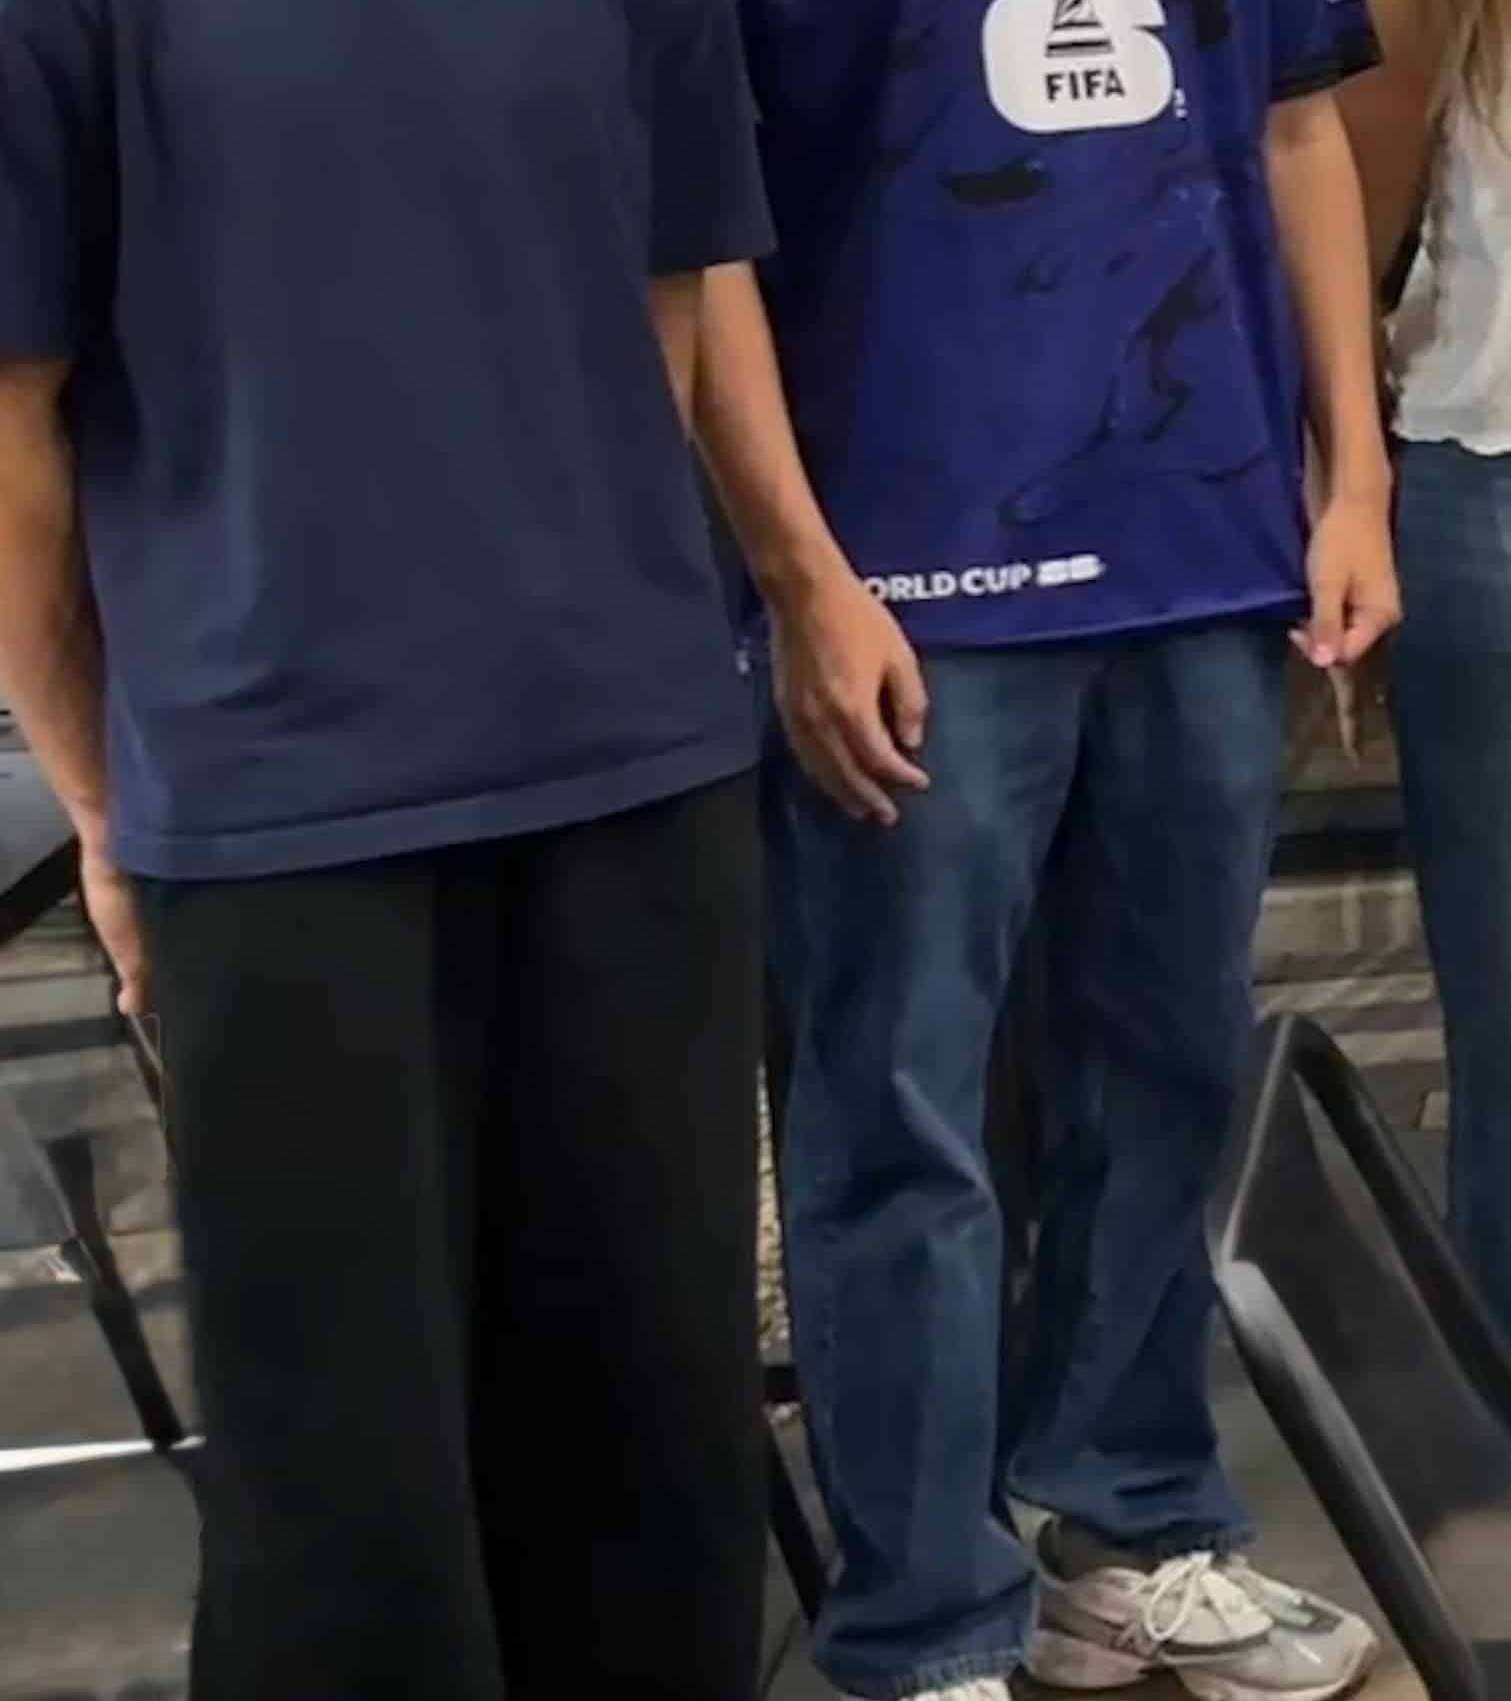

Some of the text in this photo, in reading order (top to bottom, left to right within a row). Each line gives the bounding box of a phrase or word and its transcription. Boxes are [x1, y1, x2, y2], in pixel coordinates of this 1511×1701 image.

[1045, 70, 1126, 102] FIFA
[864, 571, 956, 602] ORLD
[960, 563, 1032, 595] CUP
